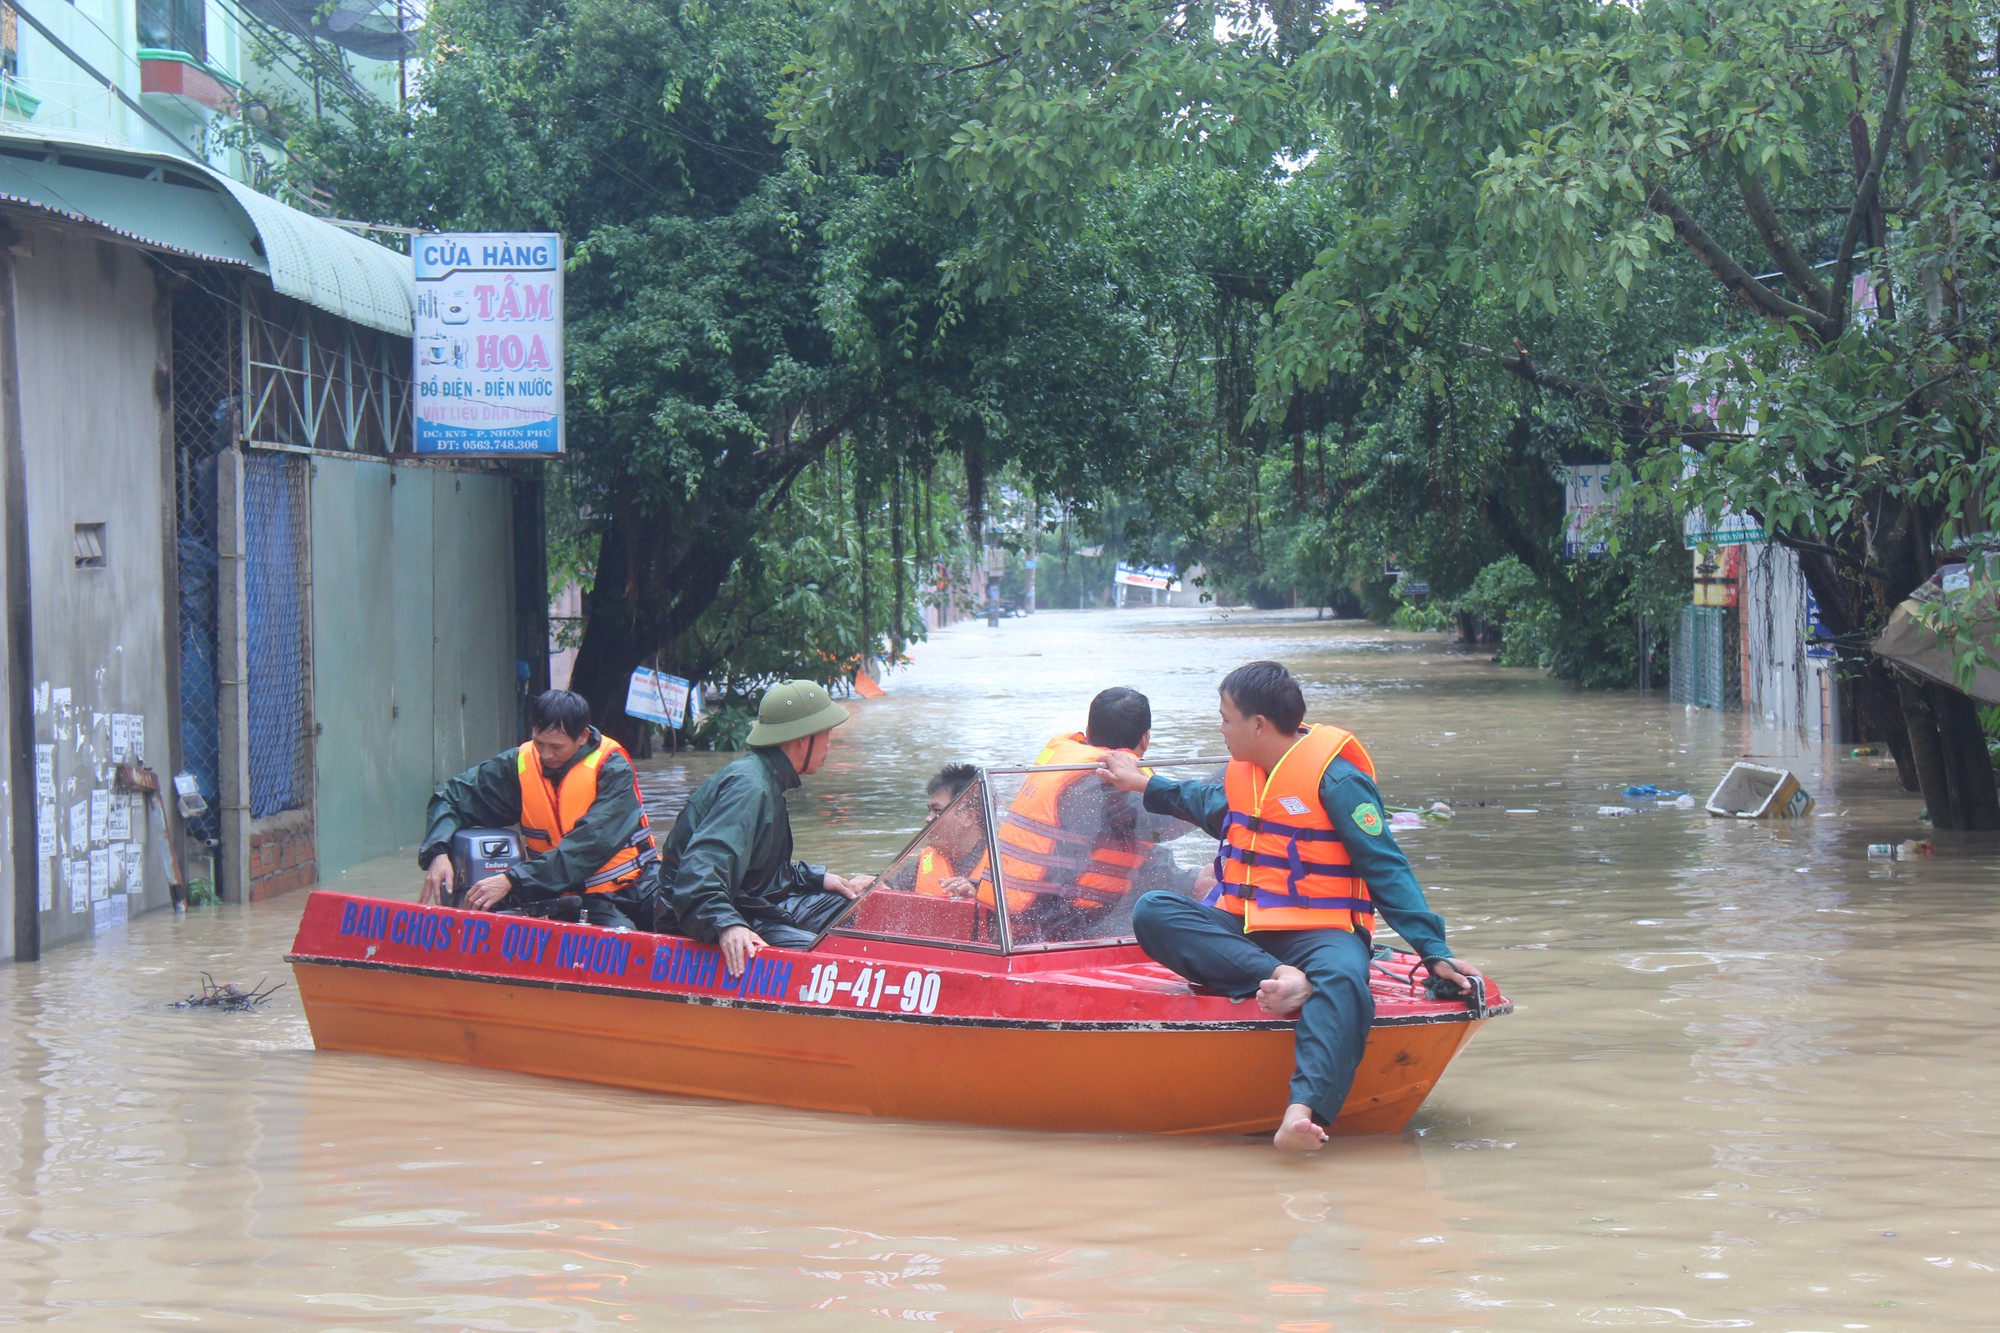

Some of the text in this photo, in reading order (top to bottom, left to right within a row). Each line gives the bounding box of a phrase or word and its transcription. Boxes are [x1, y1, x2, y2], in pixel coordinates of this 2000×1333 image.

[424, 239, 548, 266] CỬA HÀNG
[473, 274, 552, 321] TÂM
[476, 334, 552, 371] HOA
[421, 375, 438, 397] ĐỒ
[442, 377, 472, 399] ĐIỆN
[485, 377, 514, 400] ĐIỆN
[518, 376, 553, 397] NƯỚC
[437, 440, 539, 450] ĐT: 0563.748.306
[477, 430, 487, 438] P.
[490, 429, 524, 438] NHƠN
[527, 428, 552, 438] PHÚ
[340, 902, 390, 940] BAN
[391, 910, 454, 952] CHQS
[460, 918, 490, 954] TP.
[501, 923, 553, 964] QUY
[556, 932, 632, 977] NHƠN
[651, 940, 721, 989] BÌNH
[806, 963, 942, 1014] 16-41-90
